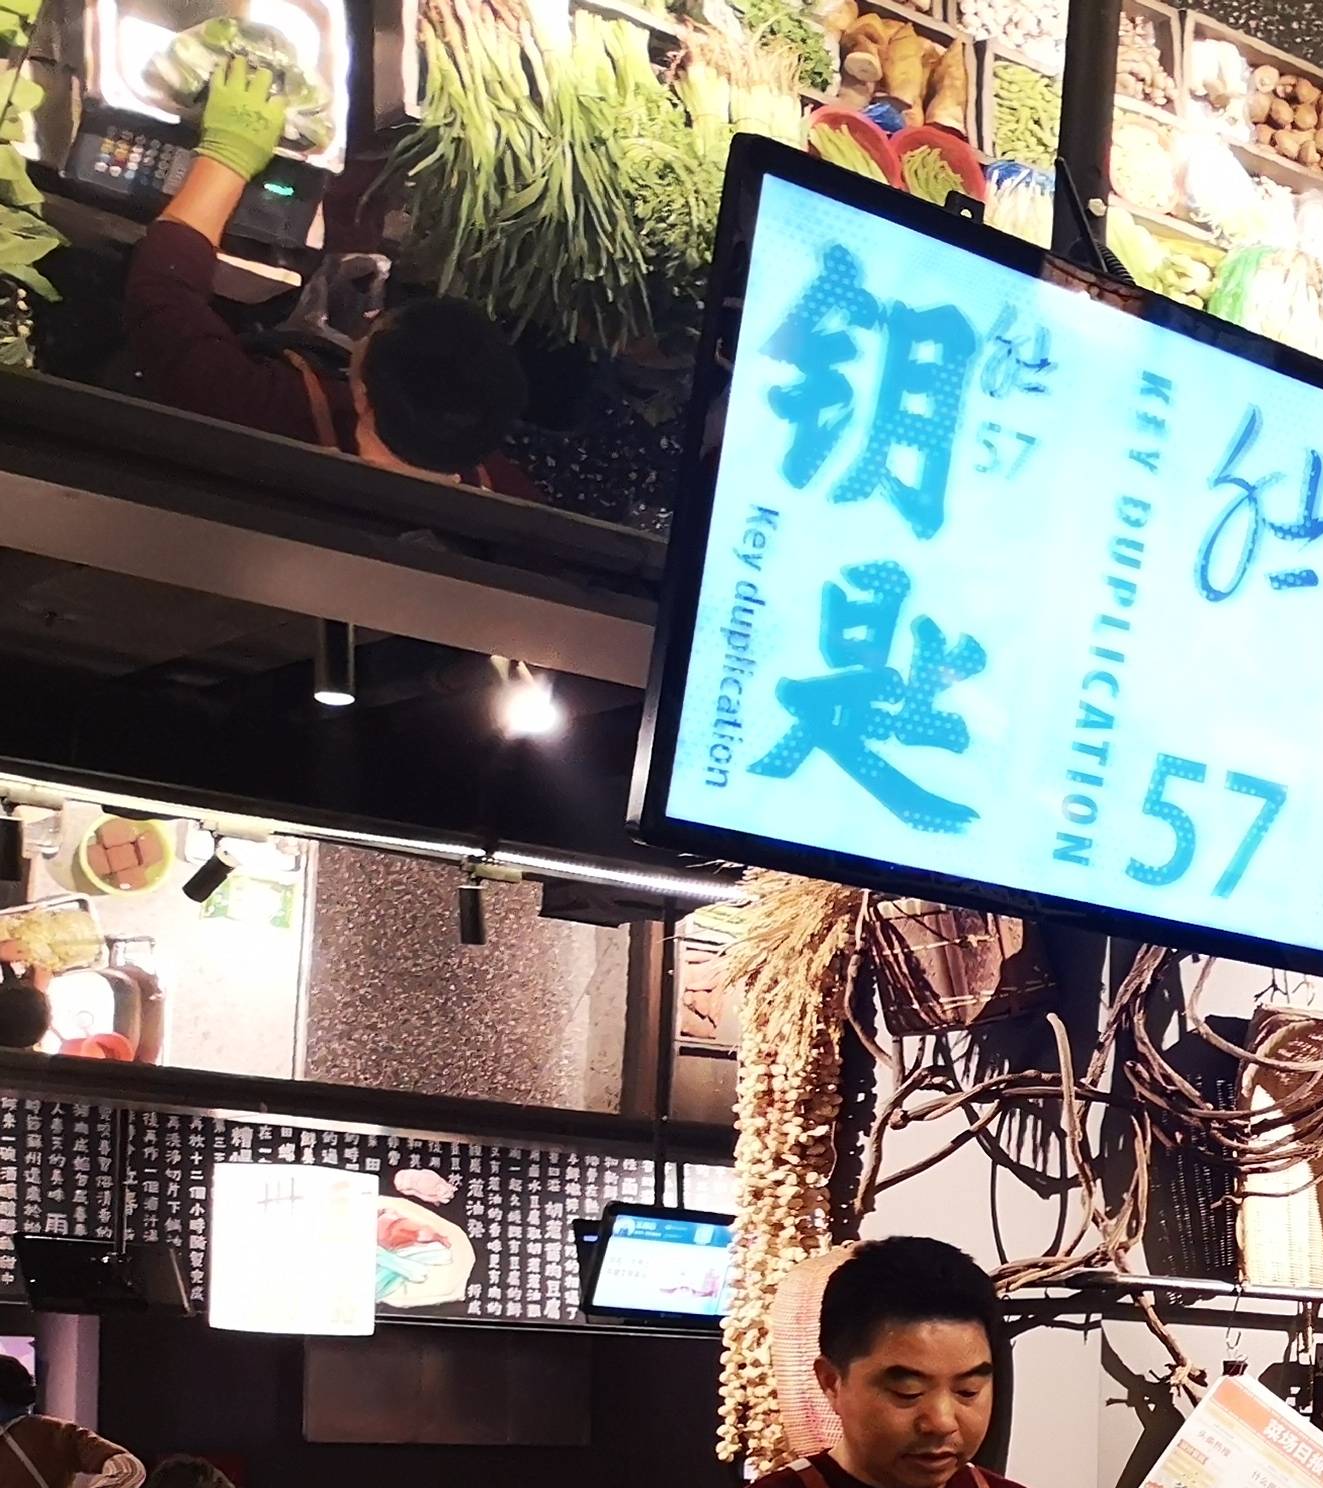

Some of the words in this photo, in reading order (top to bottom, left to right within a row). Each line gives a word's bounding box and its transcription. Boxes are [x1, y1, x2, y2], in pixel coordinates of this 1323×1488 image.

[1128, 370, 1173, 473] KEY
[733, 503, 780, 572] Key
[748, 242, 988, 837] 钥匙
[705, 579, 767, 789] duplication
[1052, 495, 1152, 867] DUPLICATION
[1122, 750, 1291, 902] 57
